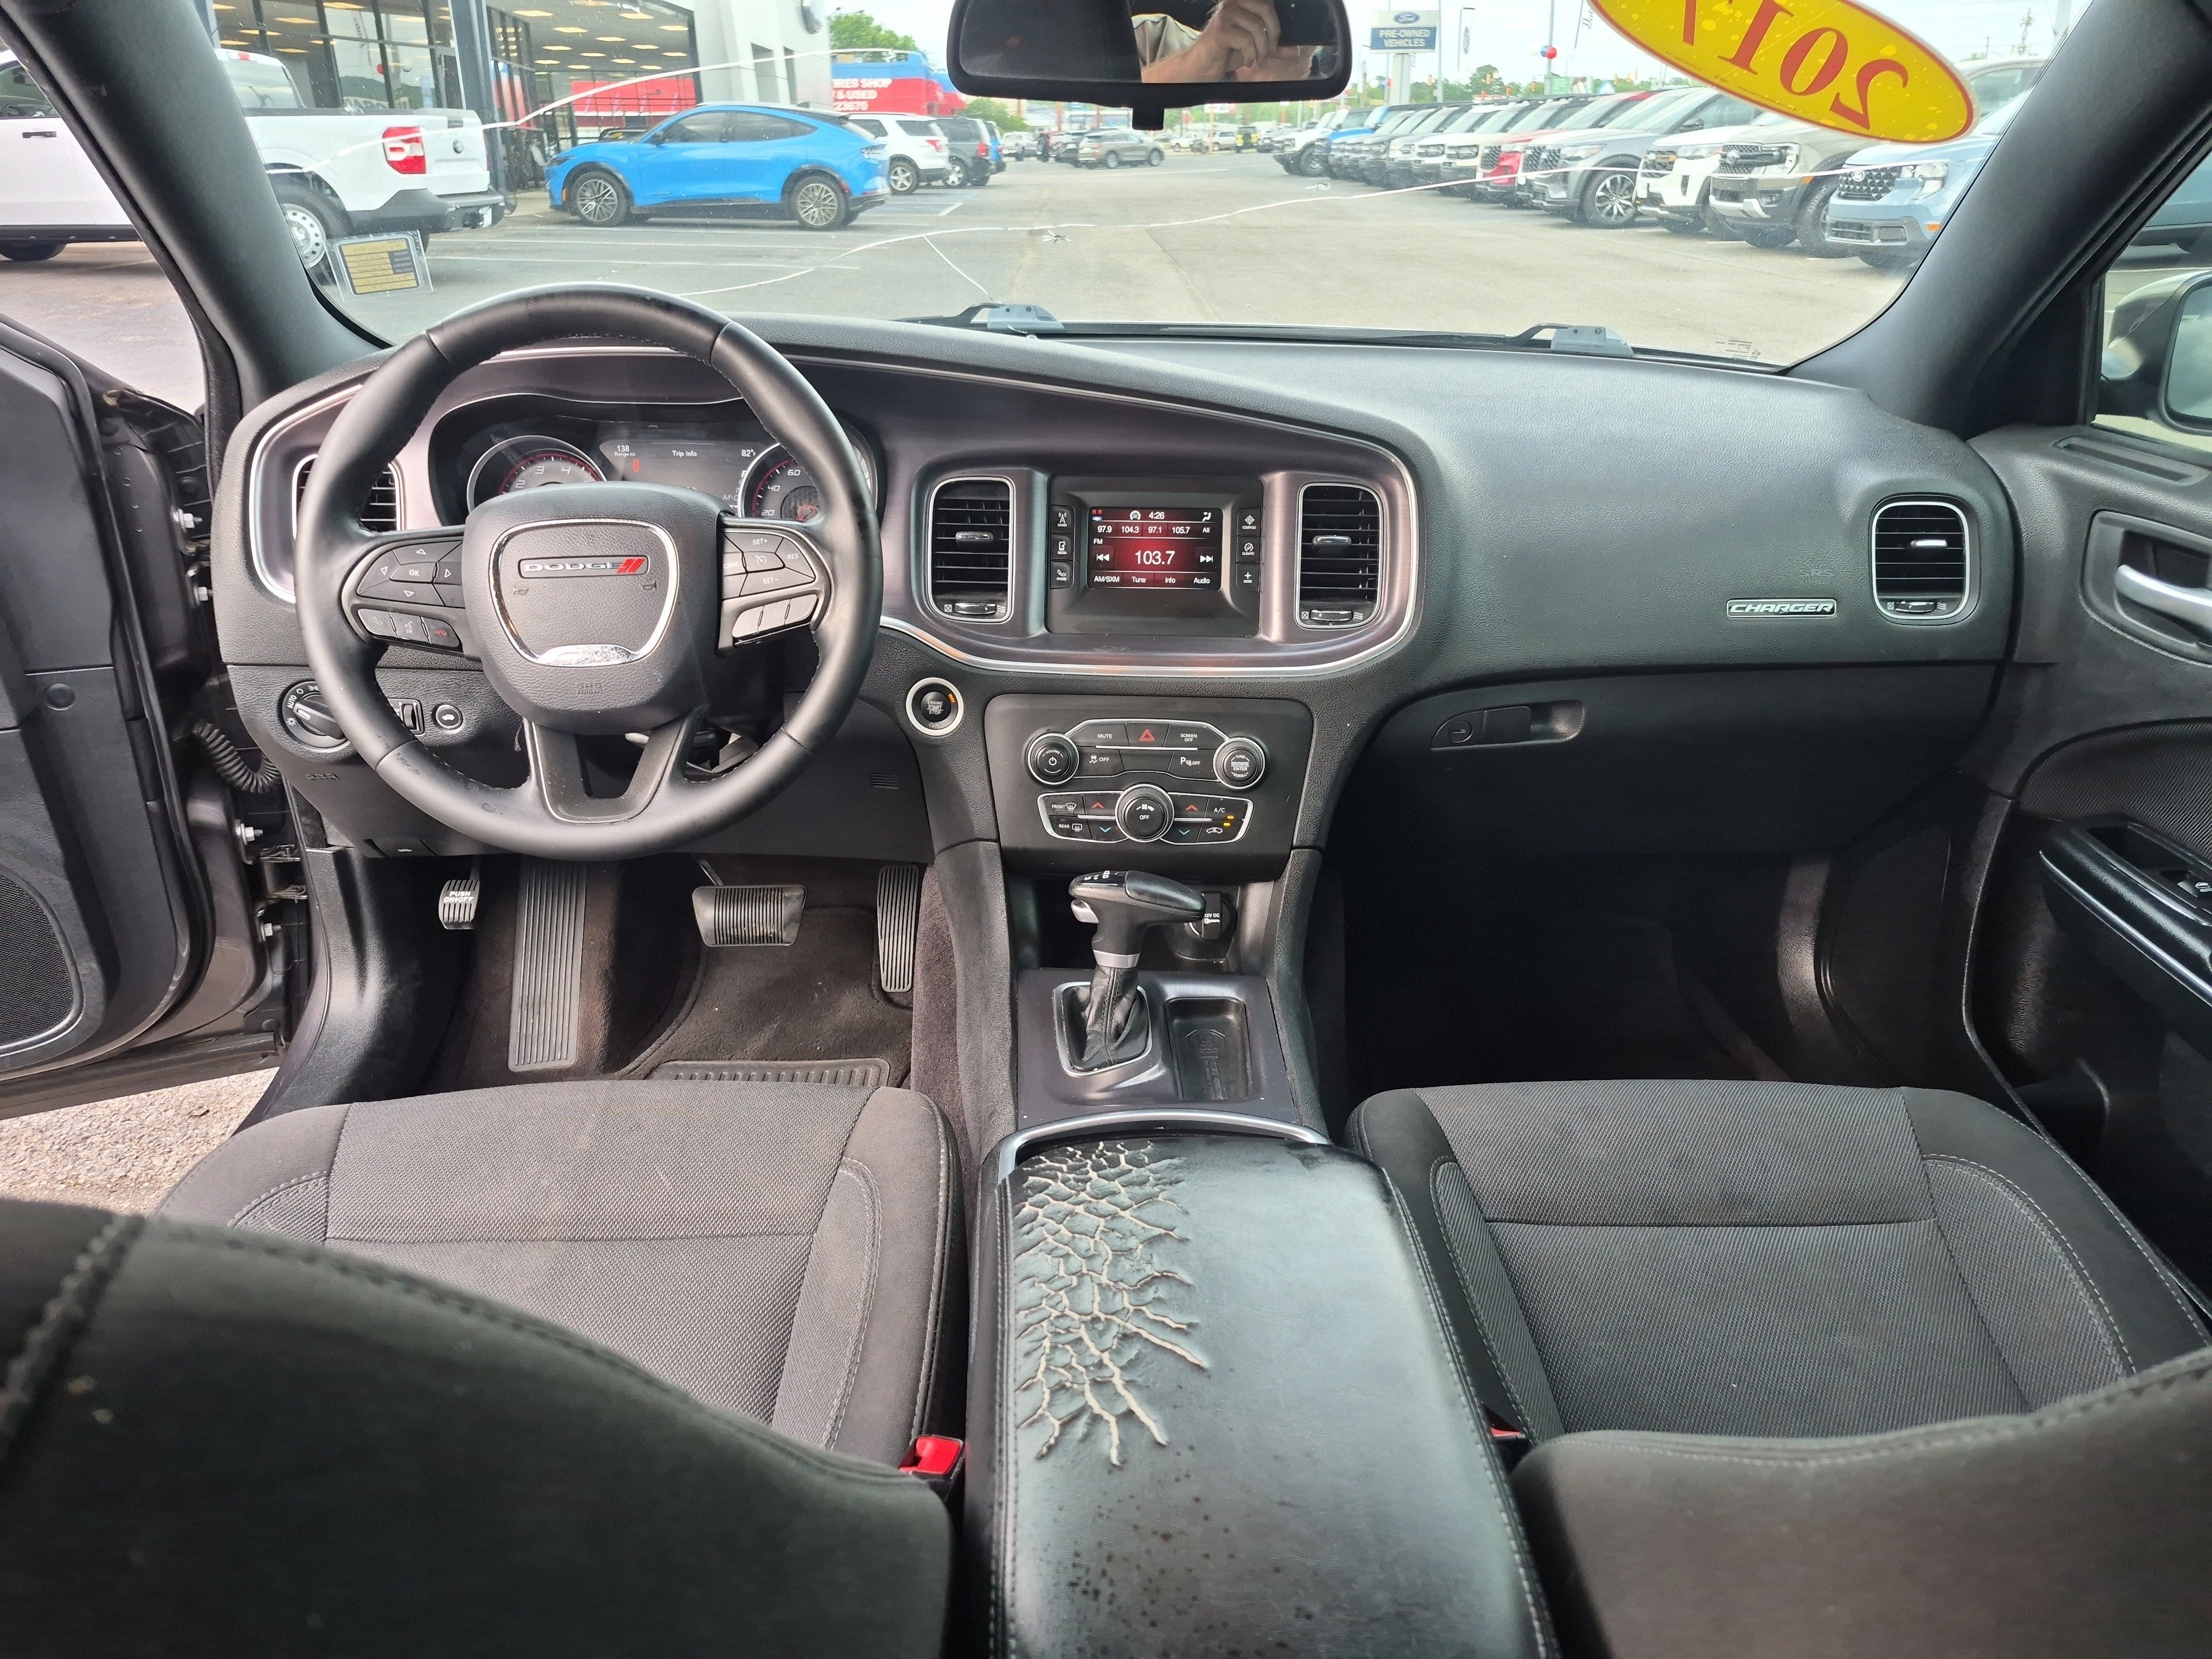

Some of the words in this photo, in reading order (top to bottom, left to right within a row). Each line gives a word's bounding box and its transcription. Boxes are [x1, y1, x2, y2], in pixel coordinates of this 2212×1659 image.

[1379, 29, 1430, 37] PRE-OWNED
[860, 79, 892, 88] SHOP
[846, 90, 877, 99] USED
[535, 466, 545, 474] 3
[561, 466, 571, 474] 4
[515, 480, 525, 488] 2
[1148, 511, 1165, 519] 4:26
[1135, 550, 1175, 565] 103.7
[524, 562, 626, 571] DODGE
[1730, 603, 1834, 613] CHARGER
[287, 695, 297, 709] AUTO
